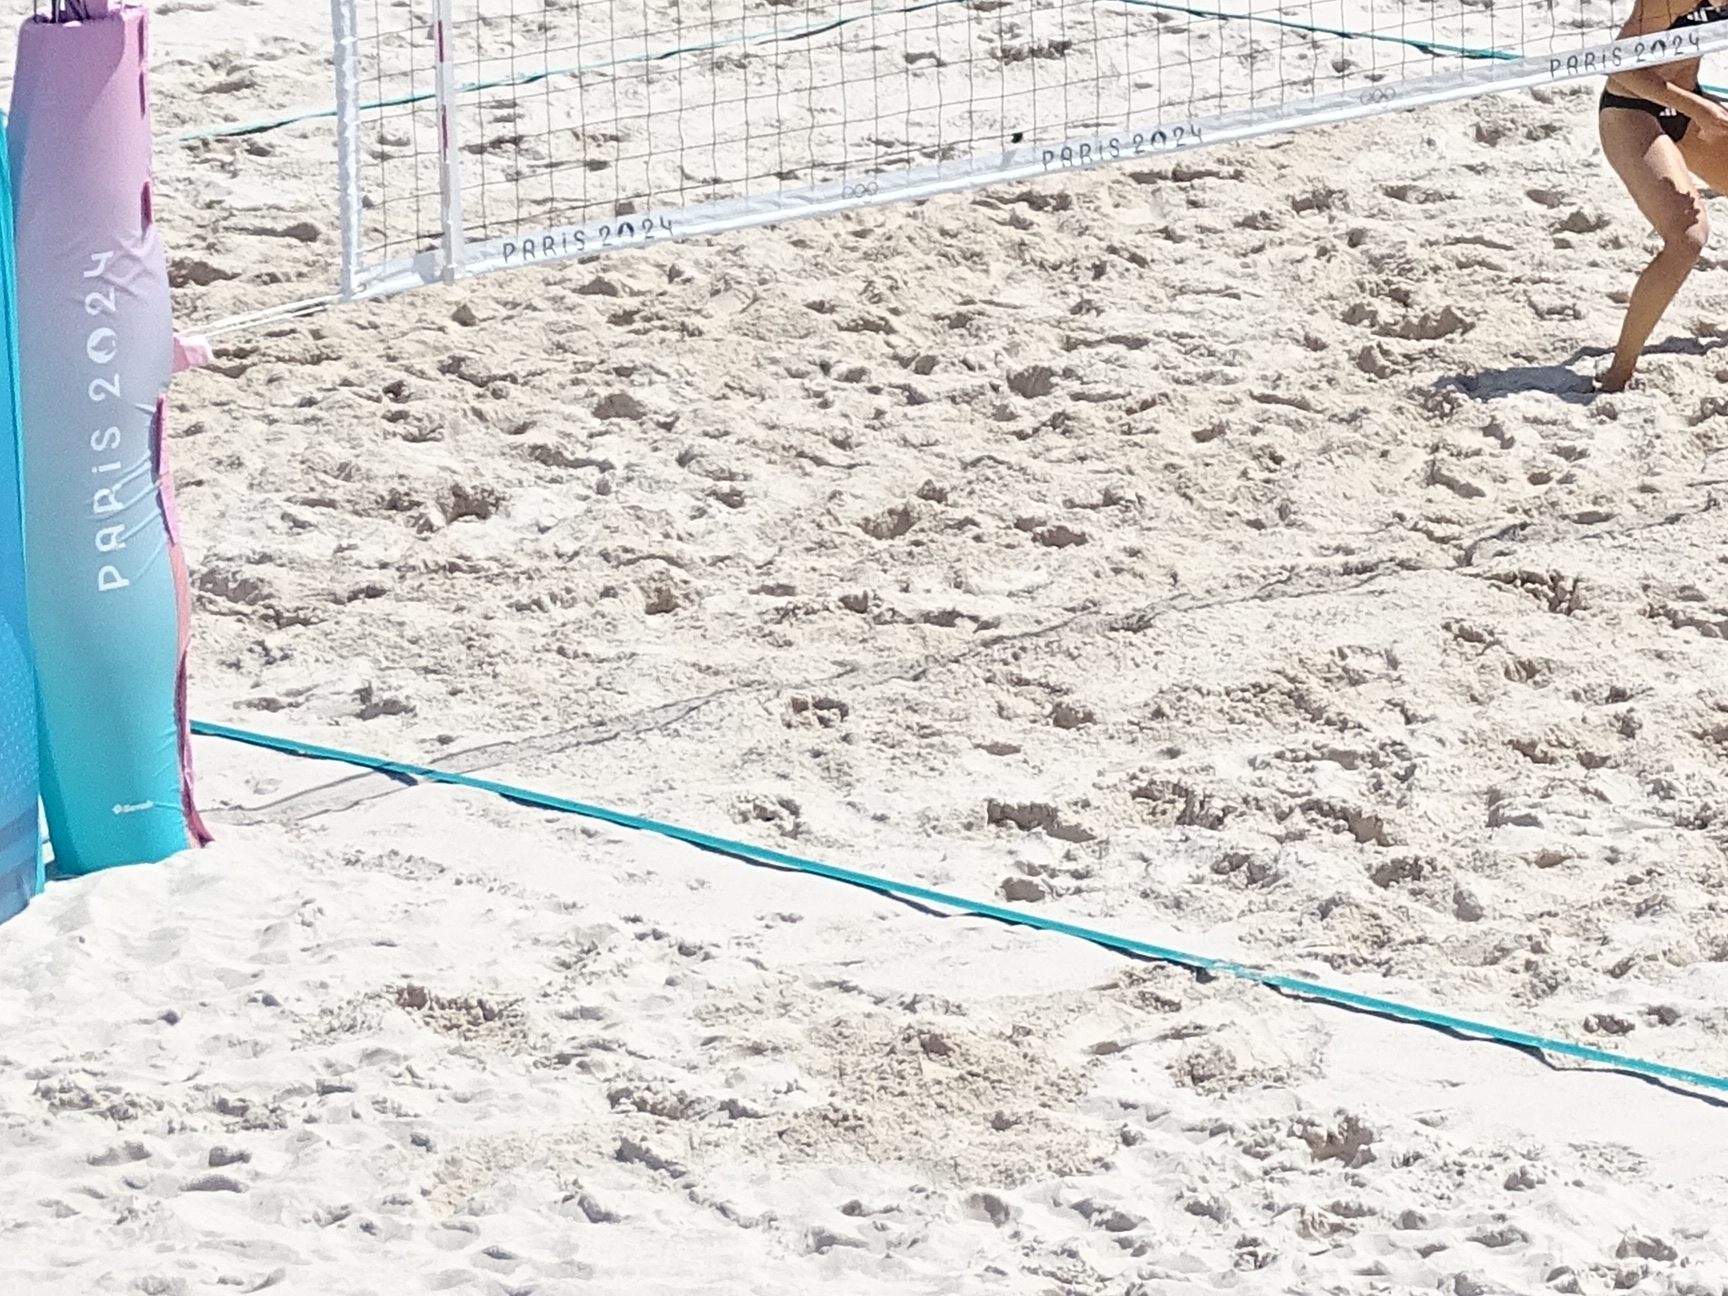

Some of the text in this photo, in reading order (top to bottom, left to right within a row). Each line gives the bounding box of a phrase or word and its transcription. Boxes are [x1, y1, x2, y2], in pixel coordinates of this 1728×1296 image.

[1550, 36, 1700, 77] PARIS 2024
[1042, 126, 1201, 169] PARIS 2024
[503, 218, 674, 264] PARIS 2024
[84, 251, 121, 401] 2024
[90, 427, 130, 591] PARIS
